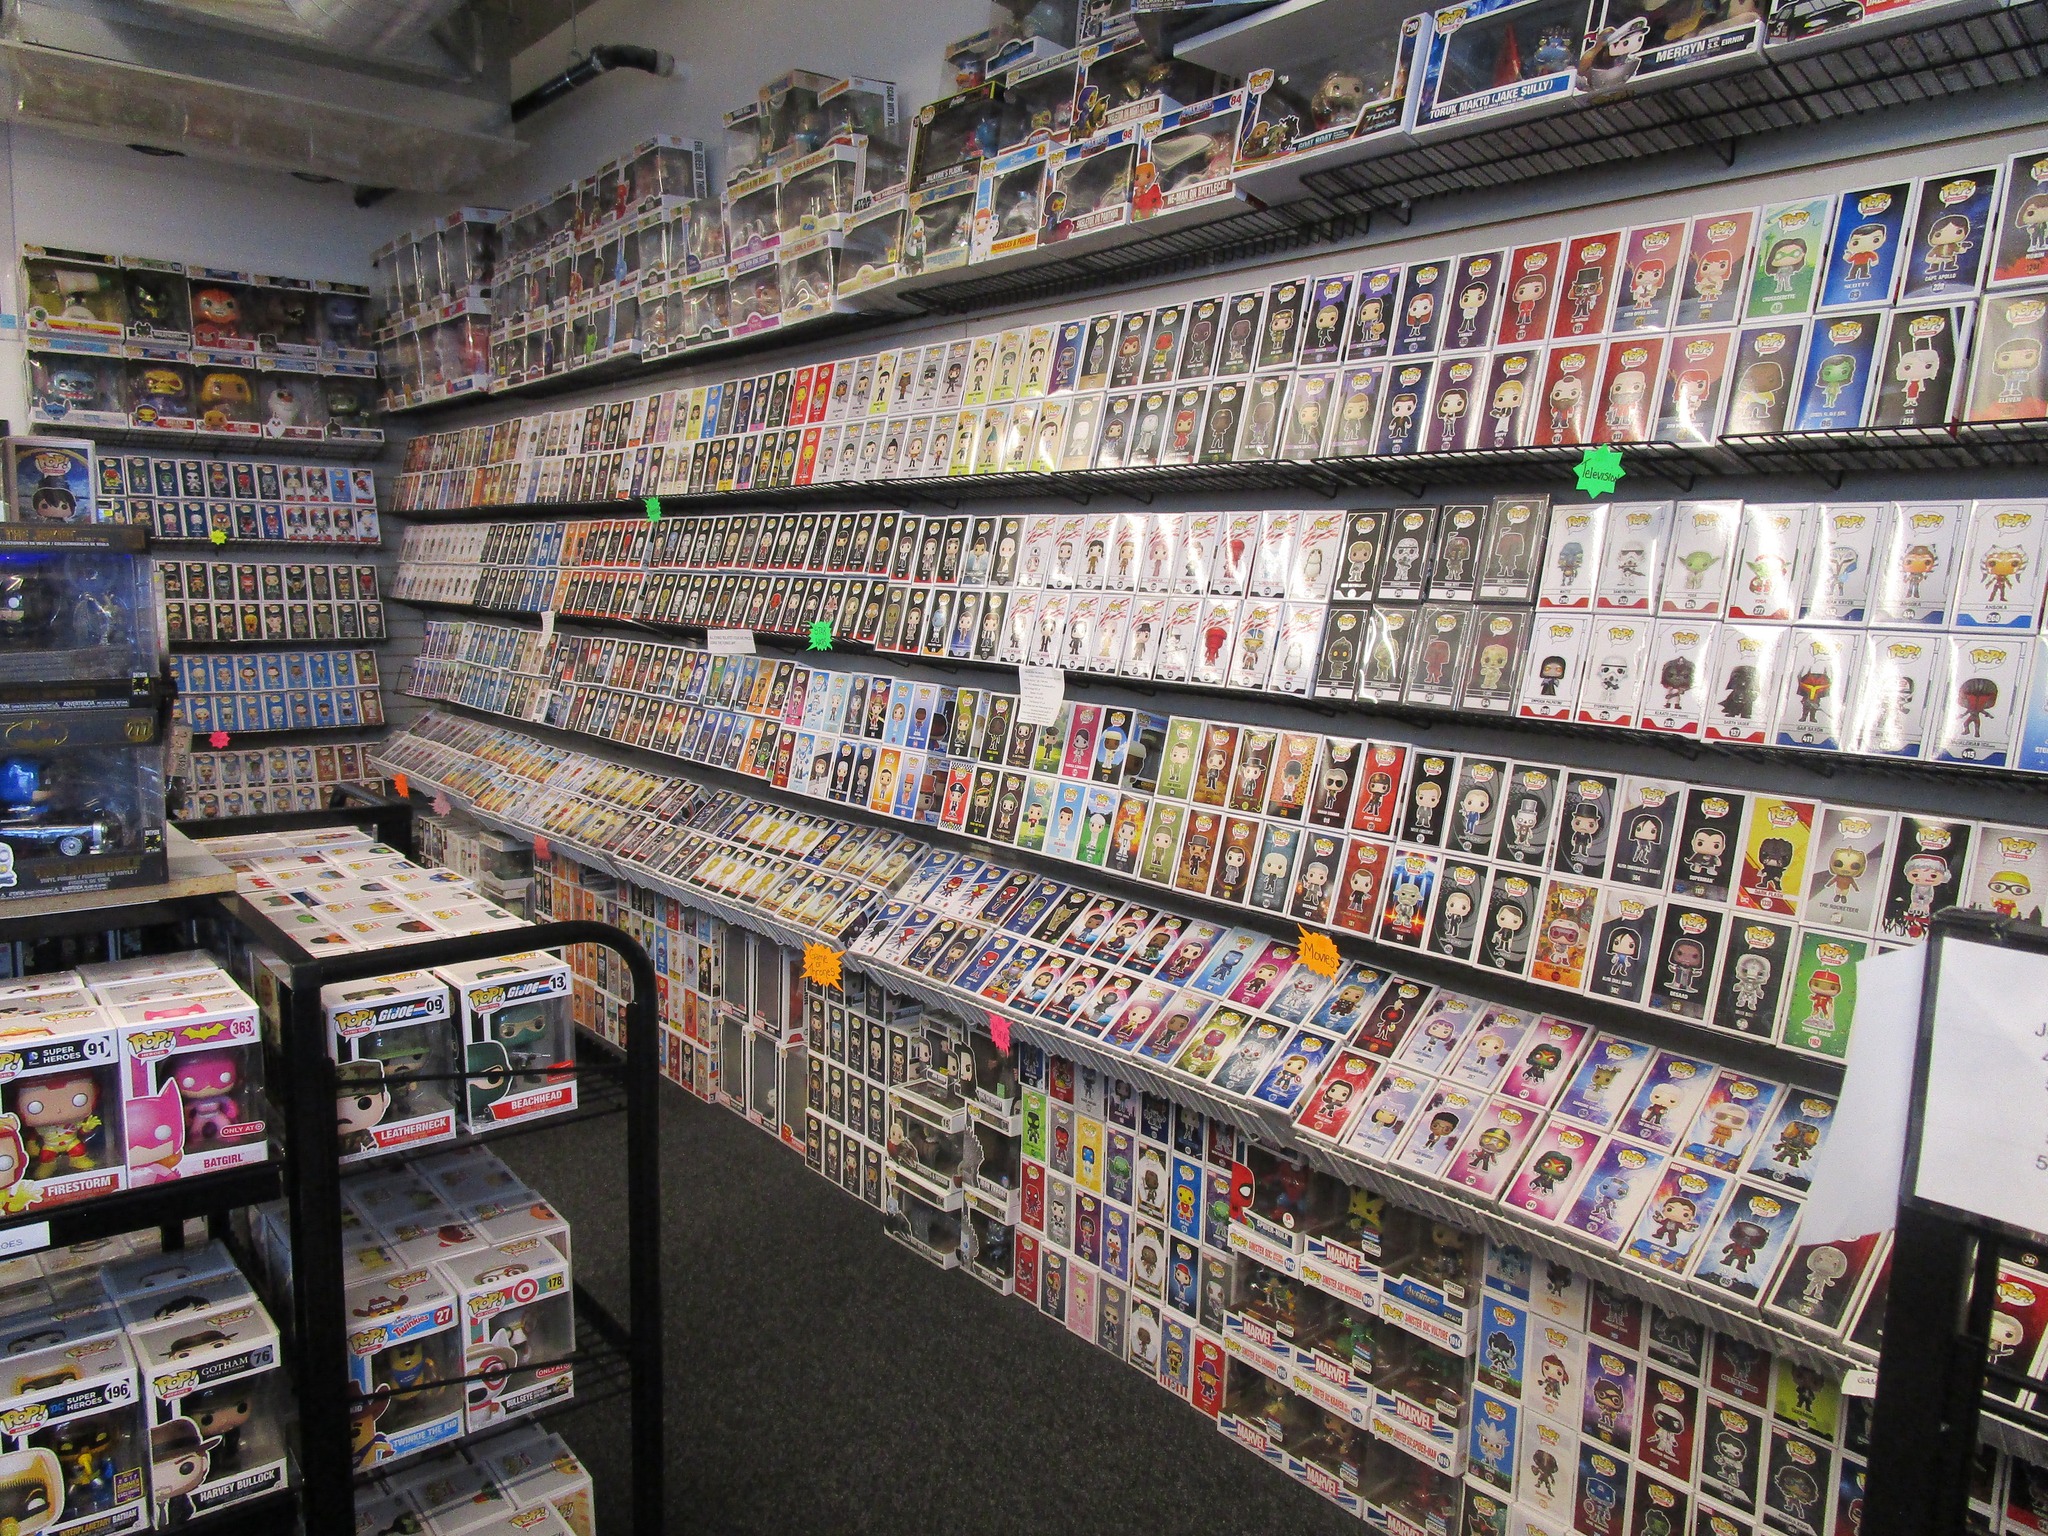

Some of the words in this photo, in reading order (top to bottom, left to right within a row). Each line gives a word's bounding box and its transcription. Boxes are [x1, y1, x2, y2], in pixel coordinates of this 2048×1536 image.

[1437, 8, 1467, 27] POP!
[1655, 40, 1706, 63] MERRYN
[1230, 95, 1242, 106] 84
[1429, 106, 1458, 120] TORUK
[1458, 96, 1490, 114] MAKTO
[1490, 87, 1520, 105] (JAKE
[1520, 79, 1554, 98] SULLY)
[1122, 130, 1133, 140] 98
[1941, 180, 1977, 199] POP!
[1859, 193, 1892, 211] POP!
[1779, 211, 1810, 228] POP!
[2007, 300, 2047, 319] POP!
[1829, 321, 1863, 339] POP!
[1910, 315, 1945, 335] POP!
[1582, 460, 1620, 483] Television
[1833, 515, 1866, 529] POP!
[1909, 514, 1945, 529] POP!
[1993, 513, 2032, 528] POP!
[1970, 649, 2007, 666] POP!
[1962, 749, 1975, 758] 415
[1640, 787, 1668, 803] POP!
[1701, 797, 1730, 812] POP!
[1768, 806, 1799, 822] POP!
[1837, 818, 1872, 835] POP!
[1917, 826, 1951, 845] POP!
[1745, 926, 1776, 943] POP!
[1303, 942, 1339, 970] Movies
[1817, 944, 1849, 961] POP!
[551, 976, 565, 989] 13
[468, 987, 503, 1006] POP!
[426, 1000, 442, 1013] 09
[232, 1020, 252, 1036] 363
[334, 1009, 376, 1031] POP!
[87, 1040, 106, 1056] 91
[127, 1031, 175, 1052] POP!
[43, 1046, 75, 1057] SUPER
[43, 1050, 82, 1065] HEROES
[511, 1090, 563, 1111] BEACHHEAD
[222, 1126, 243, 1136] ONLY
[243, 1124, 255, 1133] AT
[380, 1118, 447, 1141] LEATHERNECK
[203, 1153, 243, 1169] BATGIRL
[47, 1177, 111, 1196] FIRESTORM
[1230, 1233, 1249, 1249] POP!
[1326, 1245, 1359, 1272] MARVEL
[547, 1275, 563, 1288] 178
[1302, 1266, 1322, 1284] POP!
[467, 1293, 506, 1316] POP!
[1406, 1284, 1440, 1307] AVENGERS
[435, 1308, 451, 1323] 27
[1382, 1303, 1404, 1322] POP!
[392, 1313, 429, 1337] Twinkies
[1243, 1320, 1274, 1347] MARVEL
[1224, 1337, 1242, 1353] POP!
[1450, 1336, 1461, 1348] 1014
[201, 1356, 249, 1376] GOTHAM
[254, 1350, 270, 1364] 76
[1315, 1356, 1349, 1387] MARVEL
[155, 1370, 198, 1394] POP!
[1294, 1375, 1312, 1393] POP!
[66, 1391, 97, 1404] SUPER
[106, 1384, 128, 1400] 196
[506, 1392, 534, 1409] BULLSEYE
[49, 1402, 65, 1414] DC
[66, 1397, 103, 1412] HEROES
[0, 1404, 47, 1428] POP!
[1396, 1399, 1432, 1430] MARVEL
[391, 1428, 428, 1448] TWINKIE
[428, 1425, 443, 1440] THE
[443, 1418, 458, 1434] KID
[1236, 1423, 1266, 1450] MARVEL
[1373, 1418, 1394, 1437] POP!
[200, 1483, 235, 1503] HARVEY
[236, 1469, 276, 1491] BULLOCK
[1306, 1466, 1339, 1496] MARVEL
